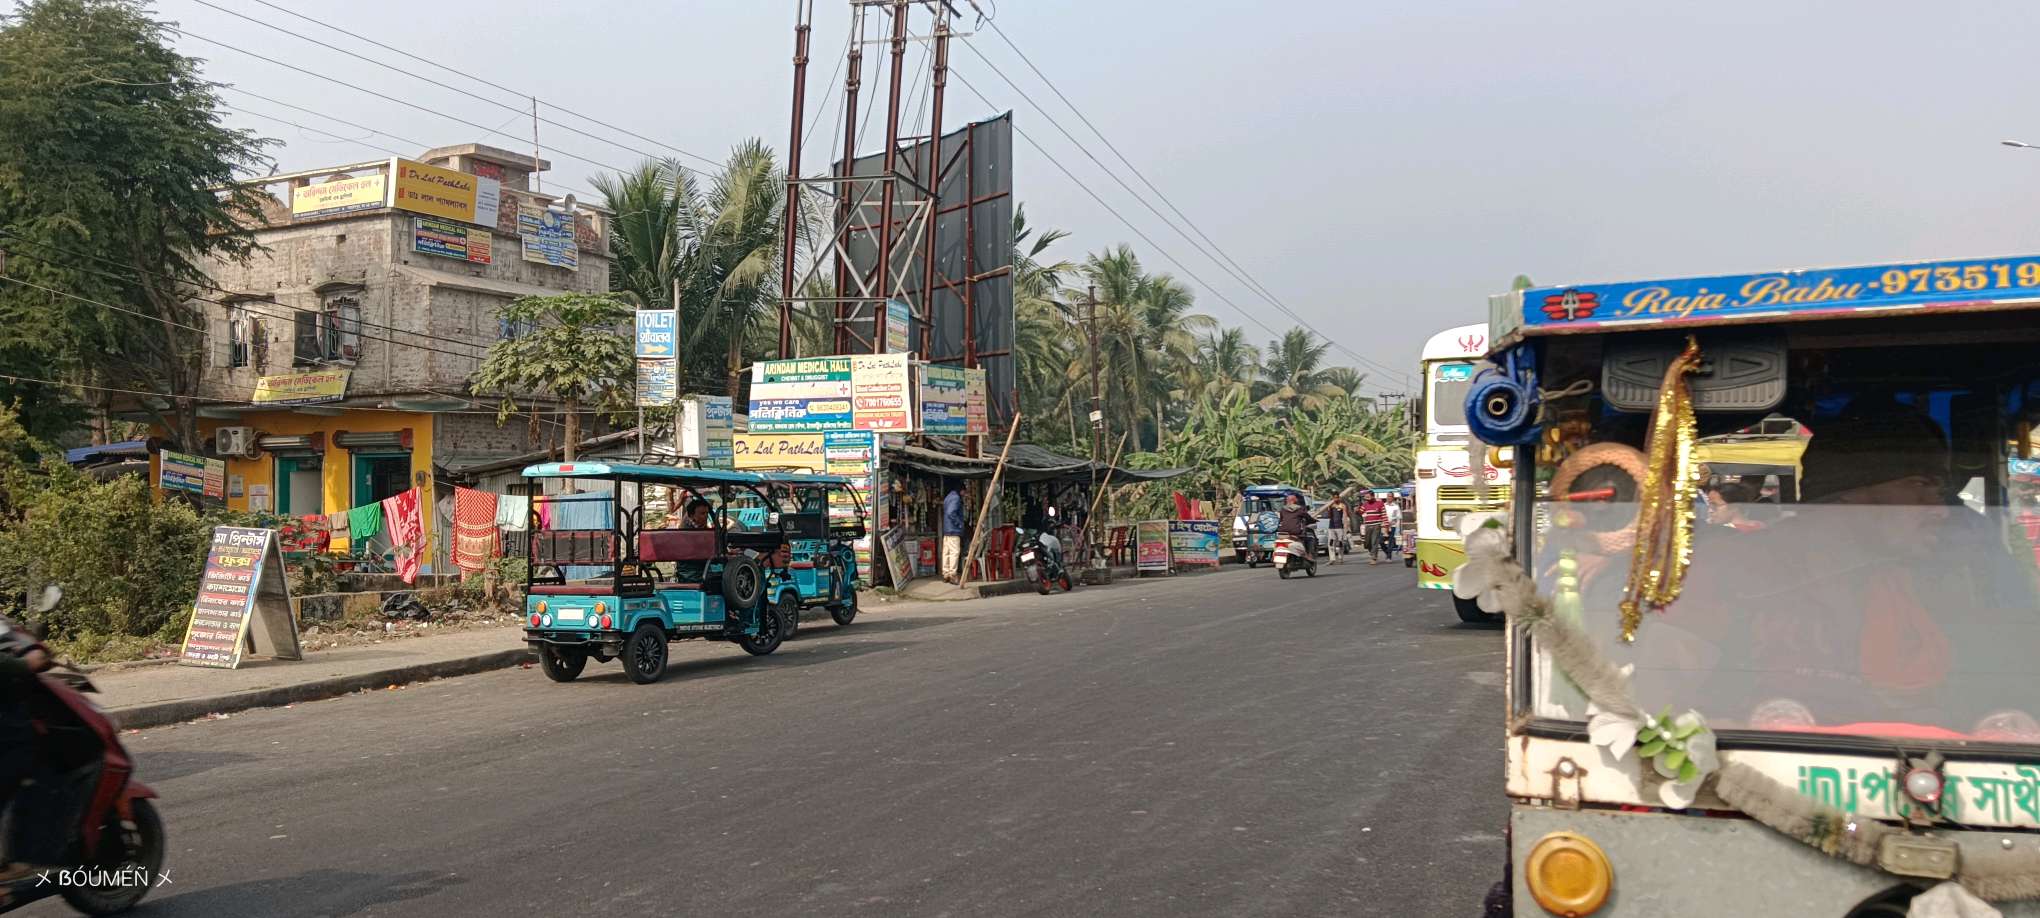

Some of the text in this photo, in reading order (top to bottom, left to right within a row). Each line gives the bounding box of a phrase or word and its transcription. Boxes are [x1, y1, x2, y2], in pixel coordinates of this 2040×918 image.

[1616, 285, 1727, 318] Raja
[1731, 276, 1866, 305] Babu
[638, 312, 673, 329] TOILET
[765, 360, 849, 376] ARINDAM MEDICAL HALL
[735, 440, 825, 455] Dr Lal PathLab
[214, 530, 266, 547] মা প্রিন্টার্স
